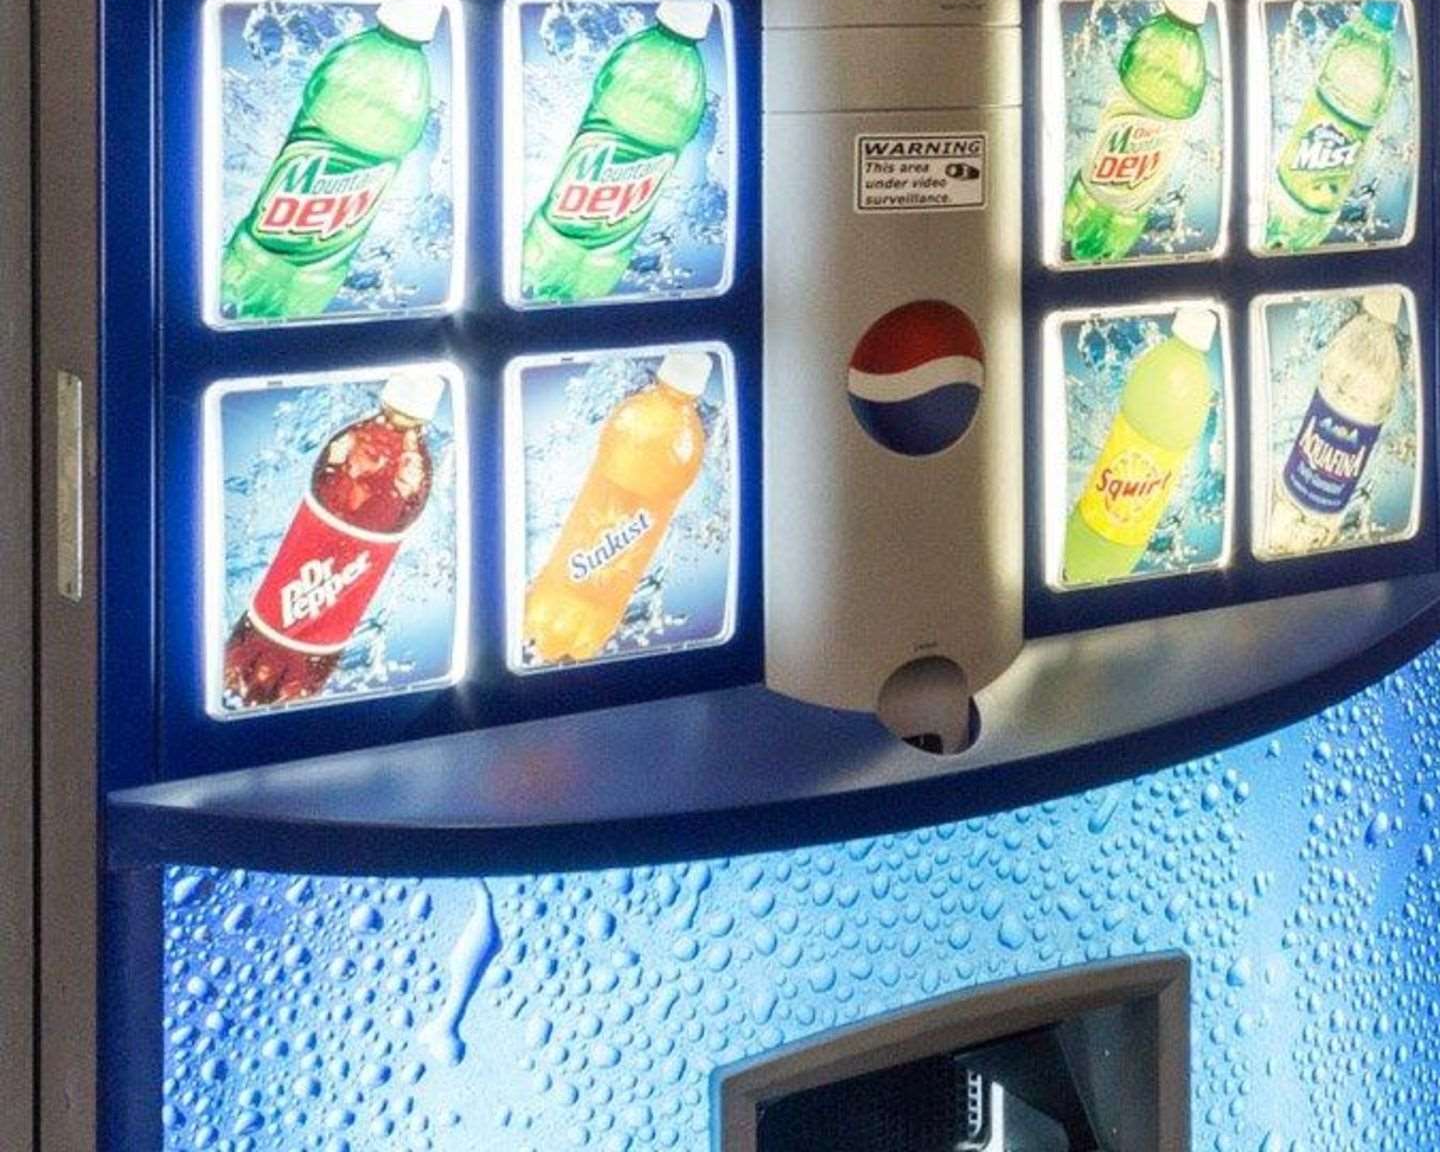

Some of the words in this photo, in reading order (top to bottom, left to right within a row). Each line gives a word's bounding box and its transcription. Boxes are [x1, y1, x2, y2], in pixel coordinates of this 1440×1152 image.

[865, 141, 981, 155] WARNING
[865, 162, 894, 174] This
[900, 163, 929, 174] area
[865, 178, 907, 190] under
[913, 177, 947, 189] video
[1299, 415, 1366, 478] AQUAFINA
[570, 511, 649, 578] Sunkist
[299, 558, 335, 593] Dr
